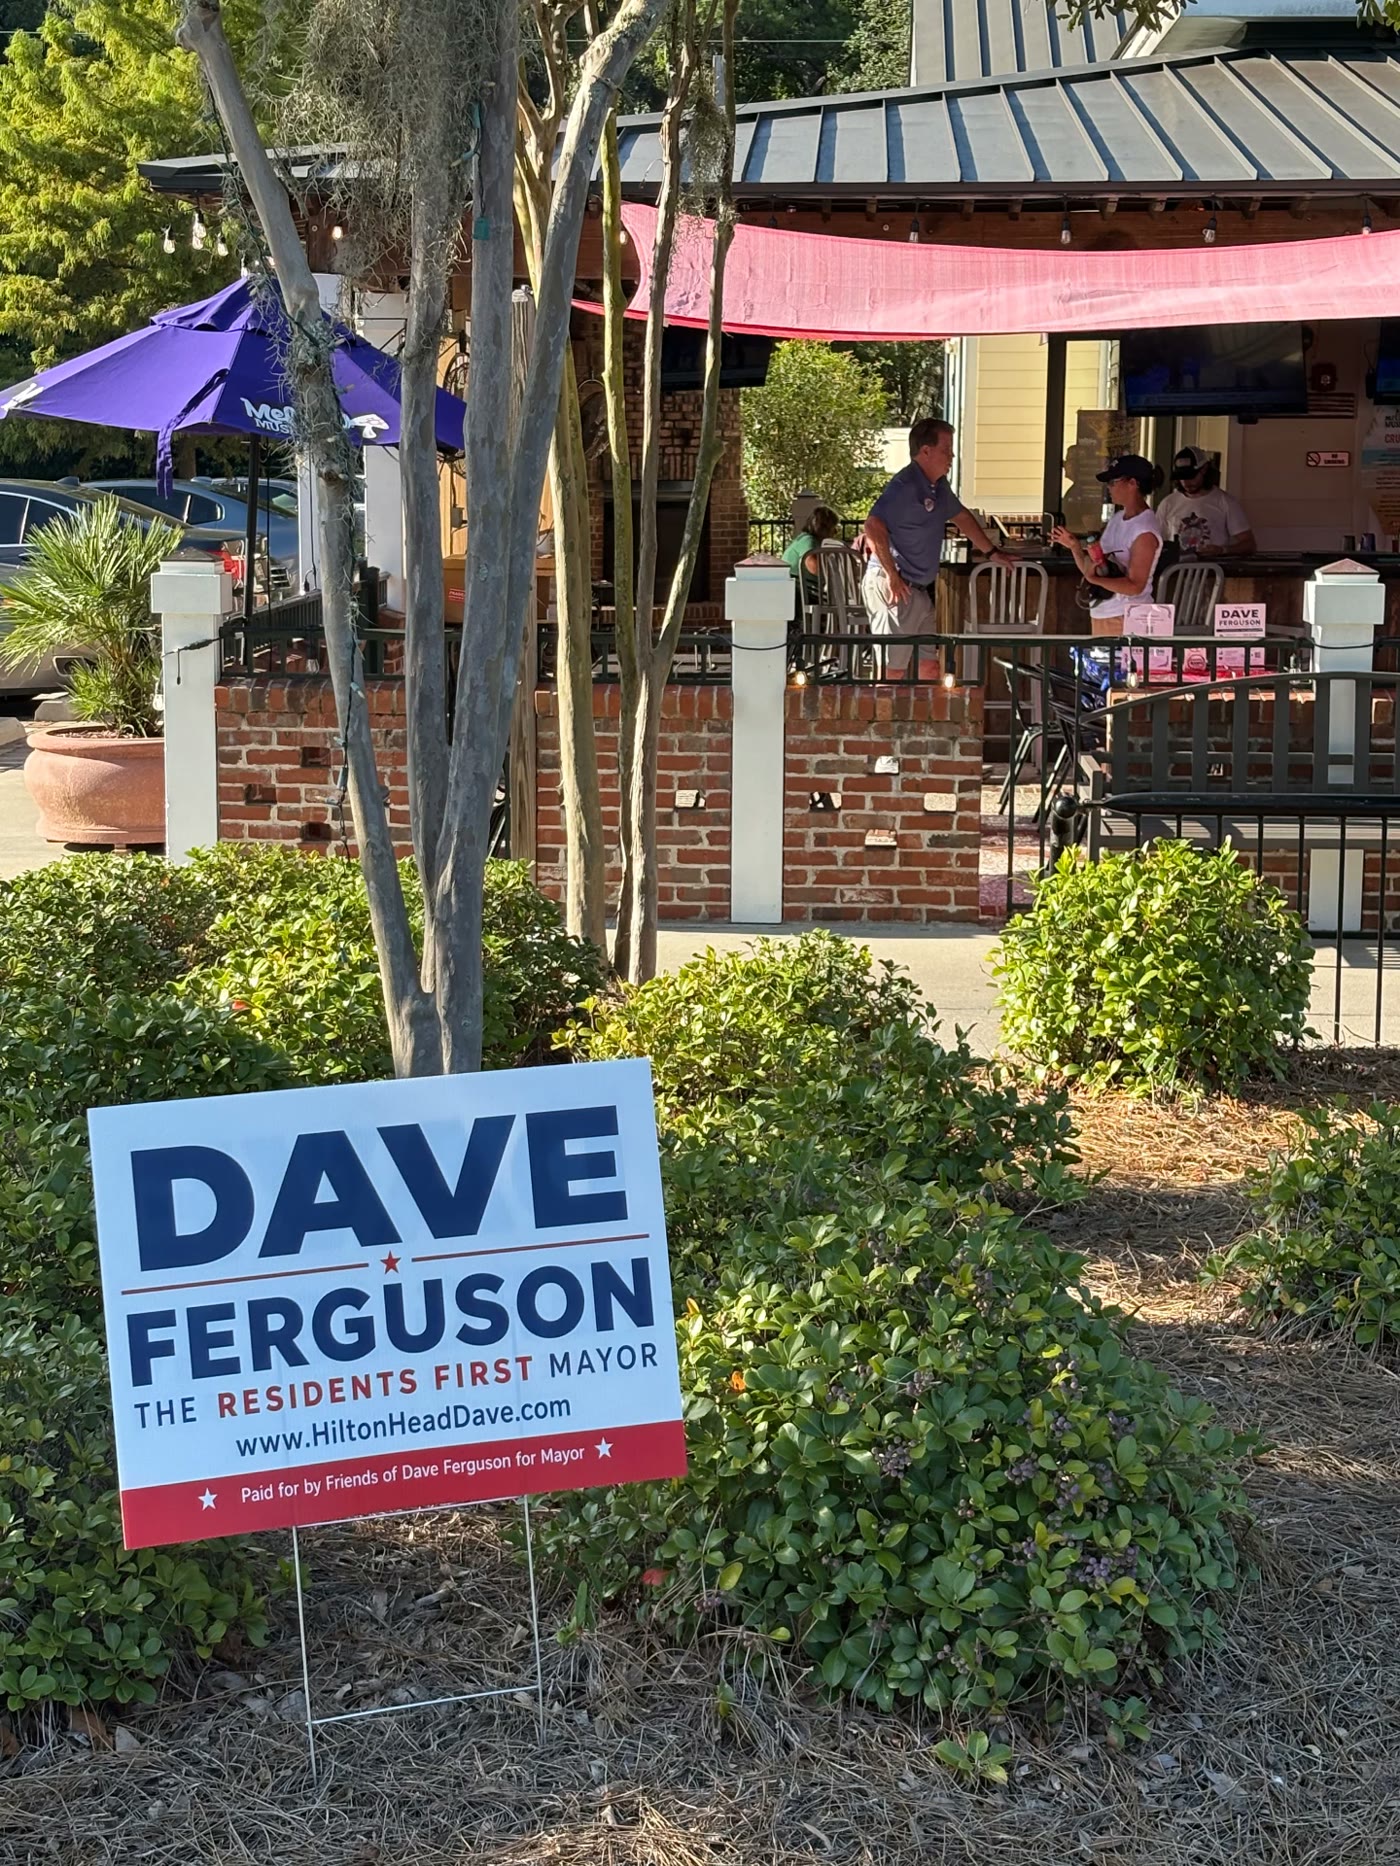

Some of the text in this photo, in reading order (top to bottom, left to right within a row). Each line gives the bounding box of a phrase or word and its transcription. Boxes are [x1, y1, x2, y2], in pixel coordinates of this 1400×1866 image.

[1221, 609, 1259, 619] DAVE
[130, 1105, 628, 1272] DAVE
[126, 1257, 655, 1387] FERGUSON
[134, 1342, 658, 1429] THE RESIDENTS FIRST MAYOR
[236, 1398, 571, 1457] www.HiltonHeadDave.com
[241, 1447, 585, 1503] Paid for by Friends of Dave Ferguson for Mayor
